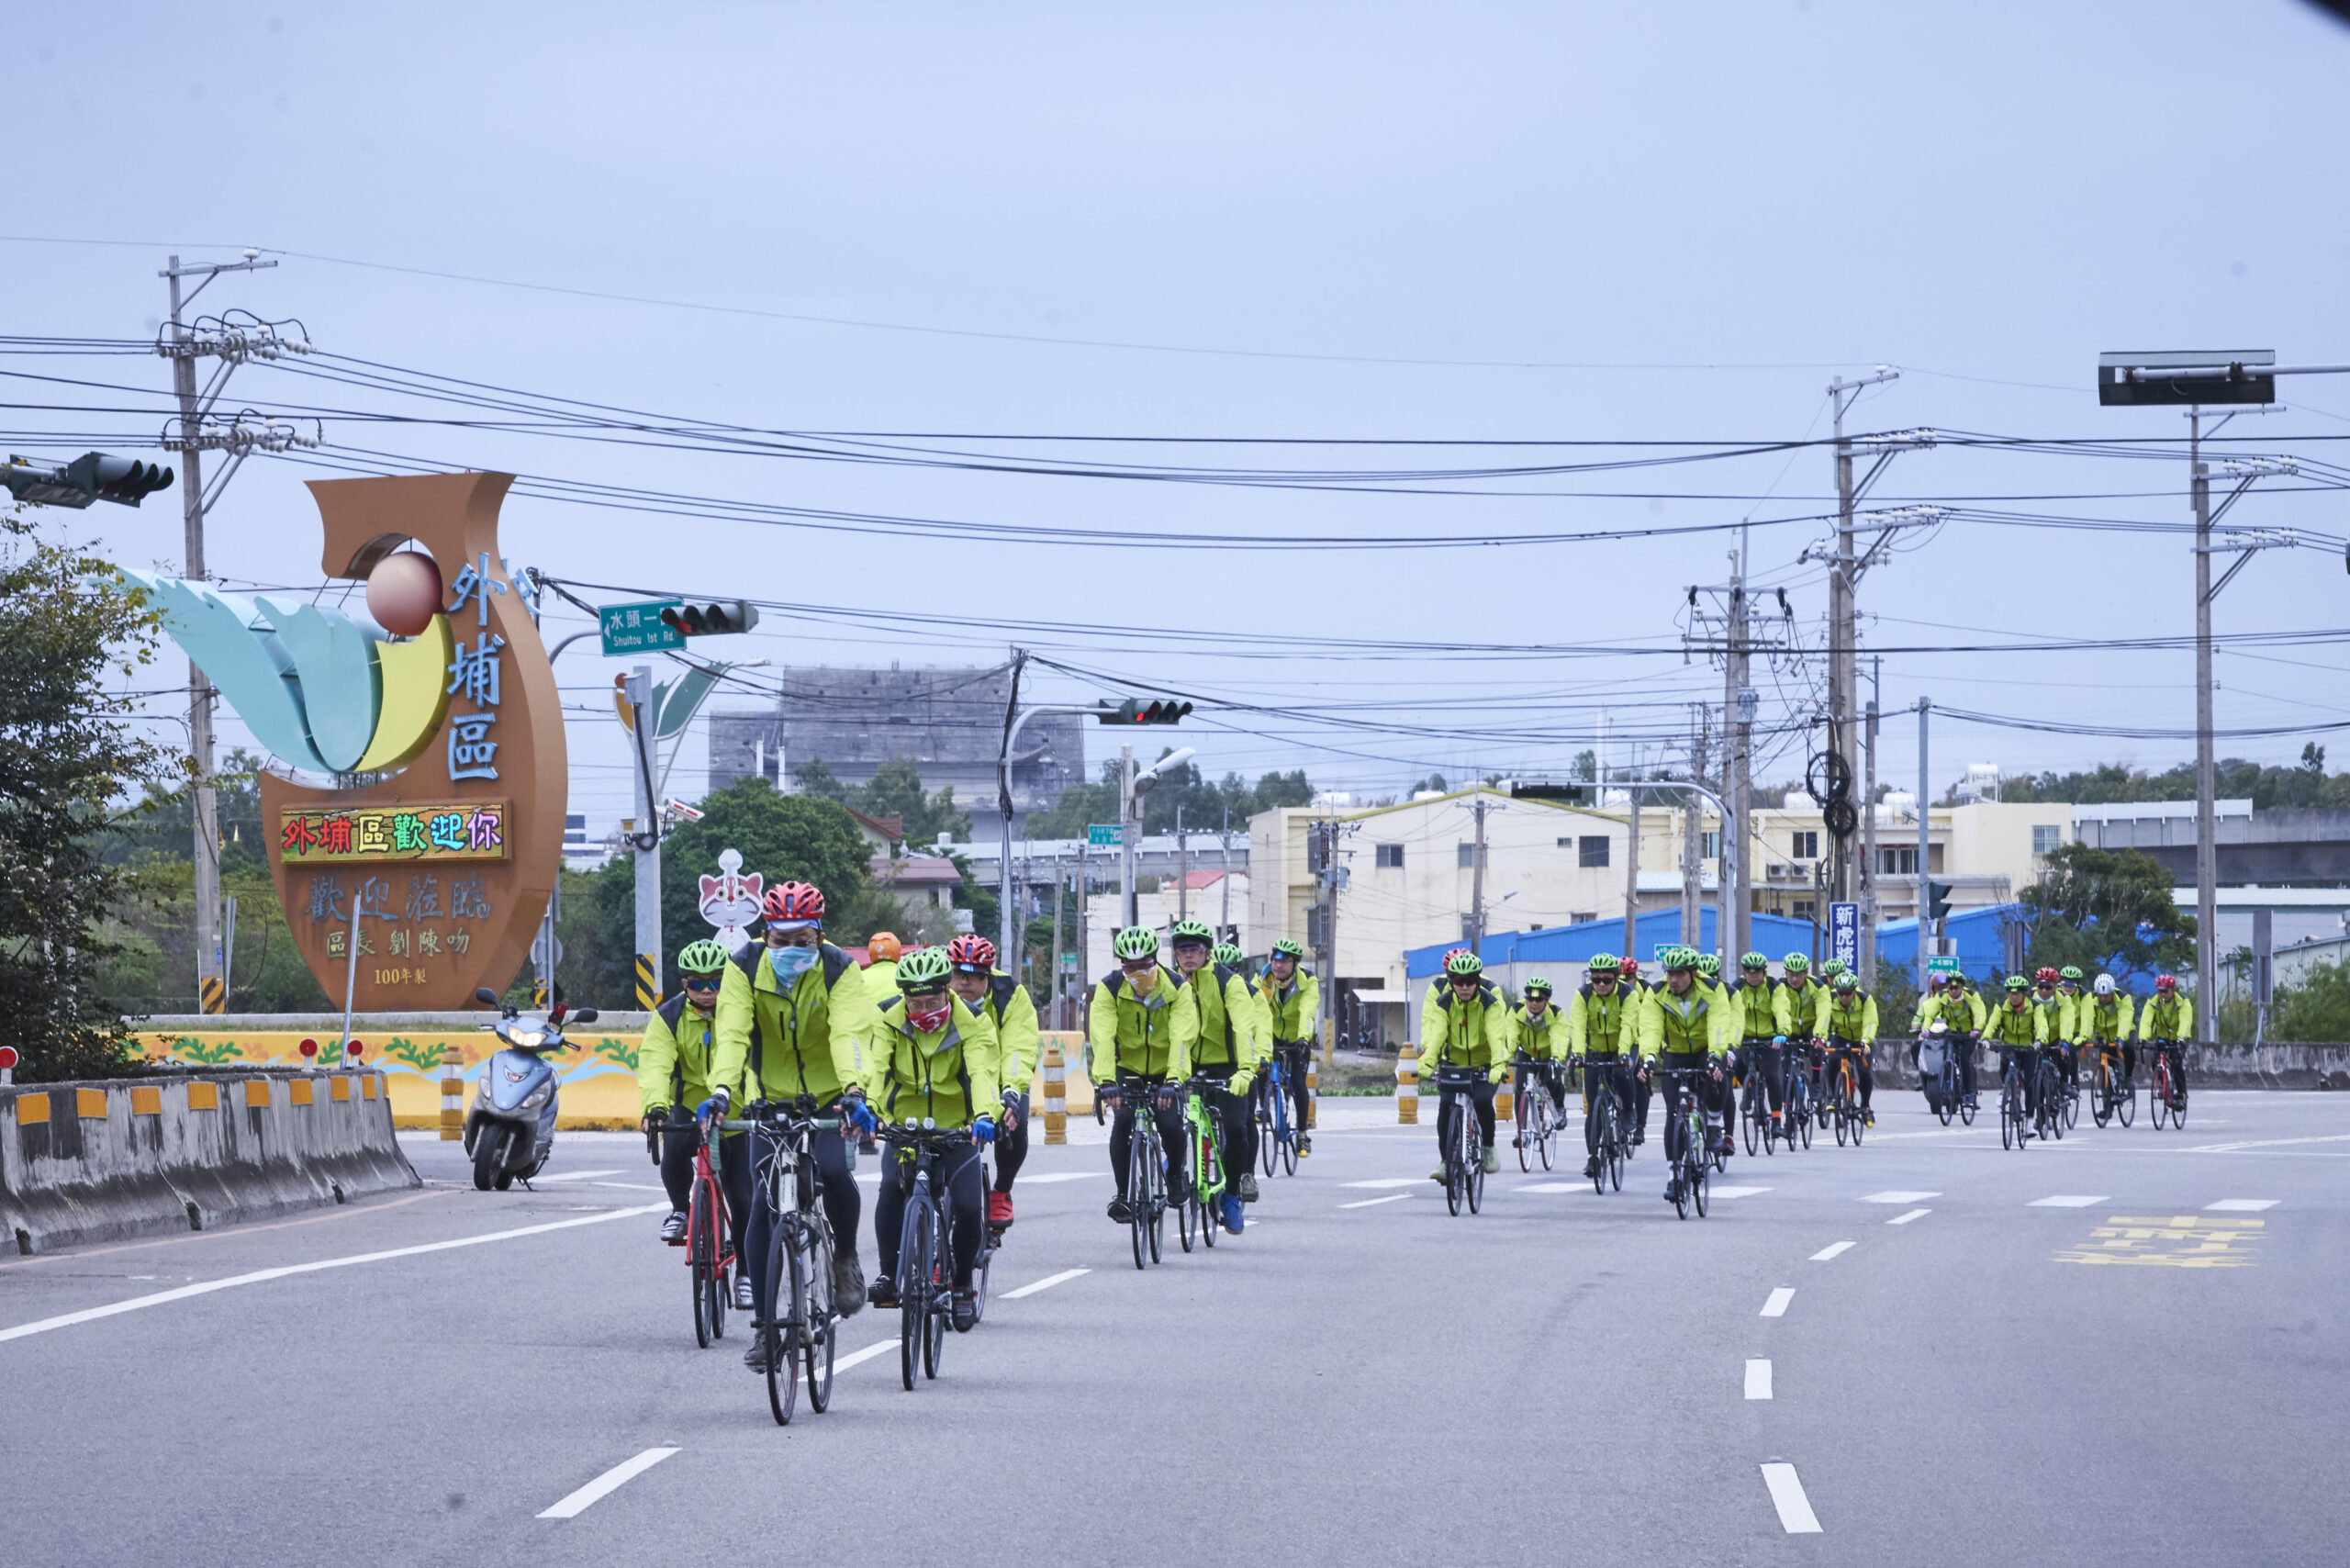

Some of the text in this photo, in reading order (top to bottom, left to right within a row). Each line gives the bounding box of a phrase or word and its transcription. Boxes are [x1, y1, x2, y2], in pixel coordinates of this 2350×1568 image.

[610, 607, 665, 630] 水頭一
[613, 636, 642, 646] Shuitou
[446, 552, 507, 781] 外埔區
[281, 812, 502, 856] 外埔區歡迎你
[304, 872, 492, 924] 歡迎蒞臨
[1836, 905, 1854, 973] 新虎將
[375, 968, 427, 985] 100年製
